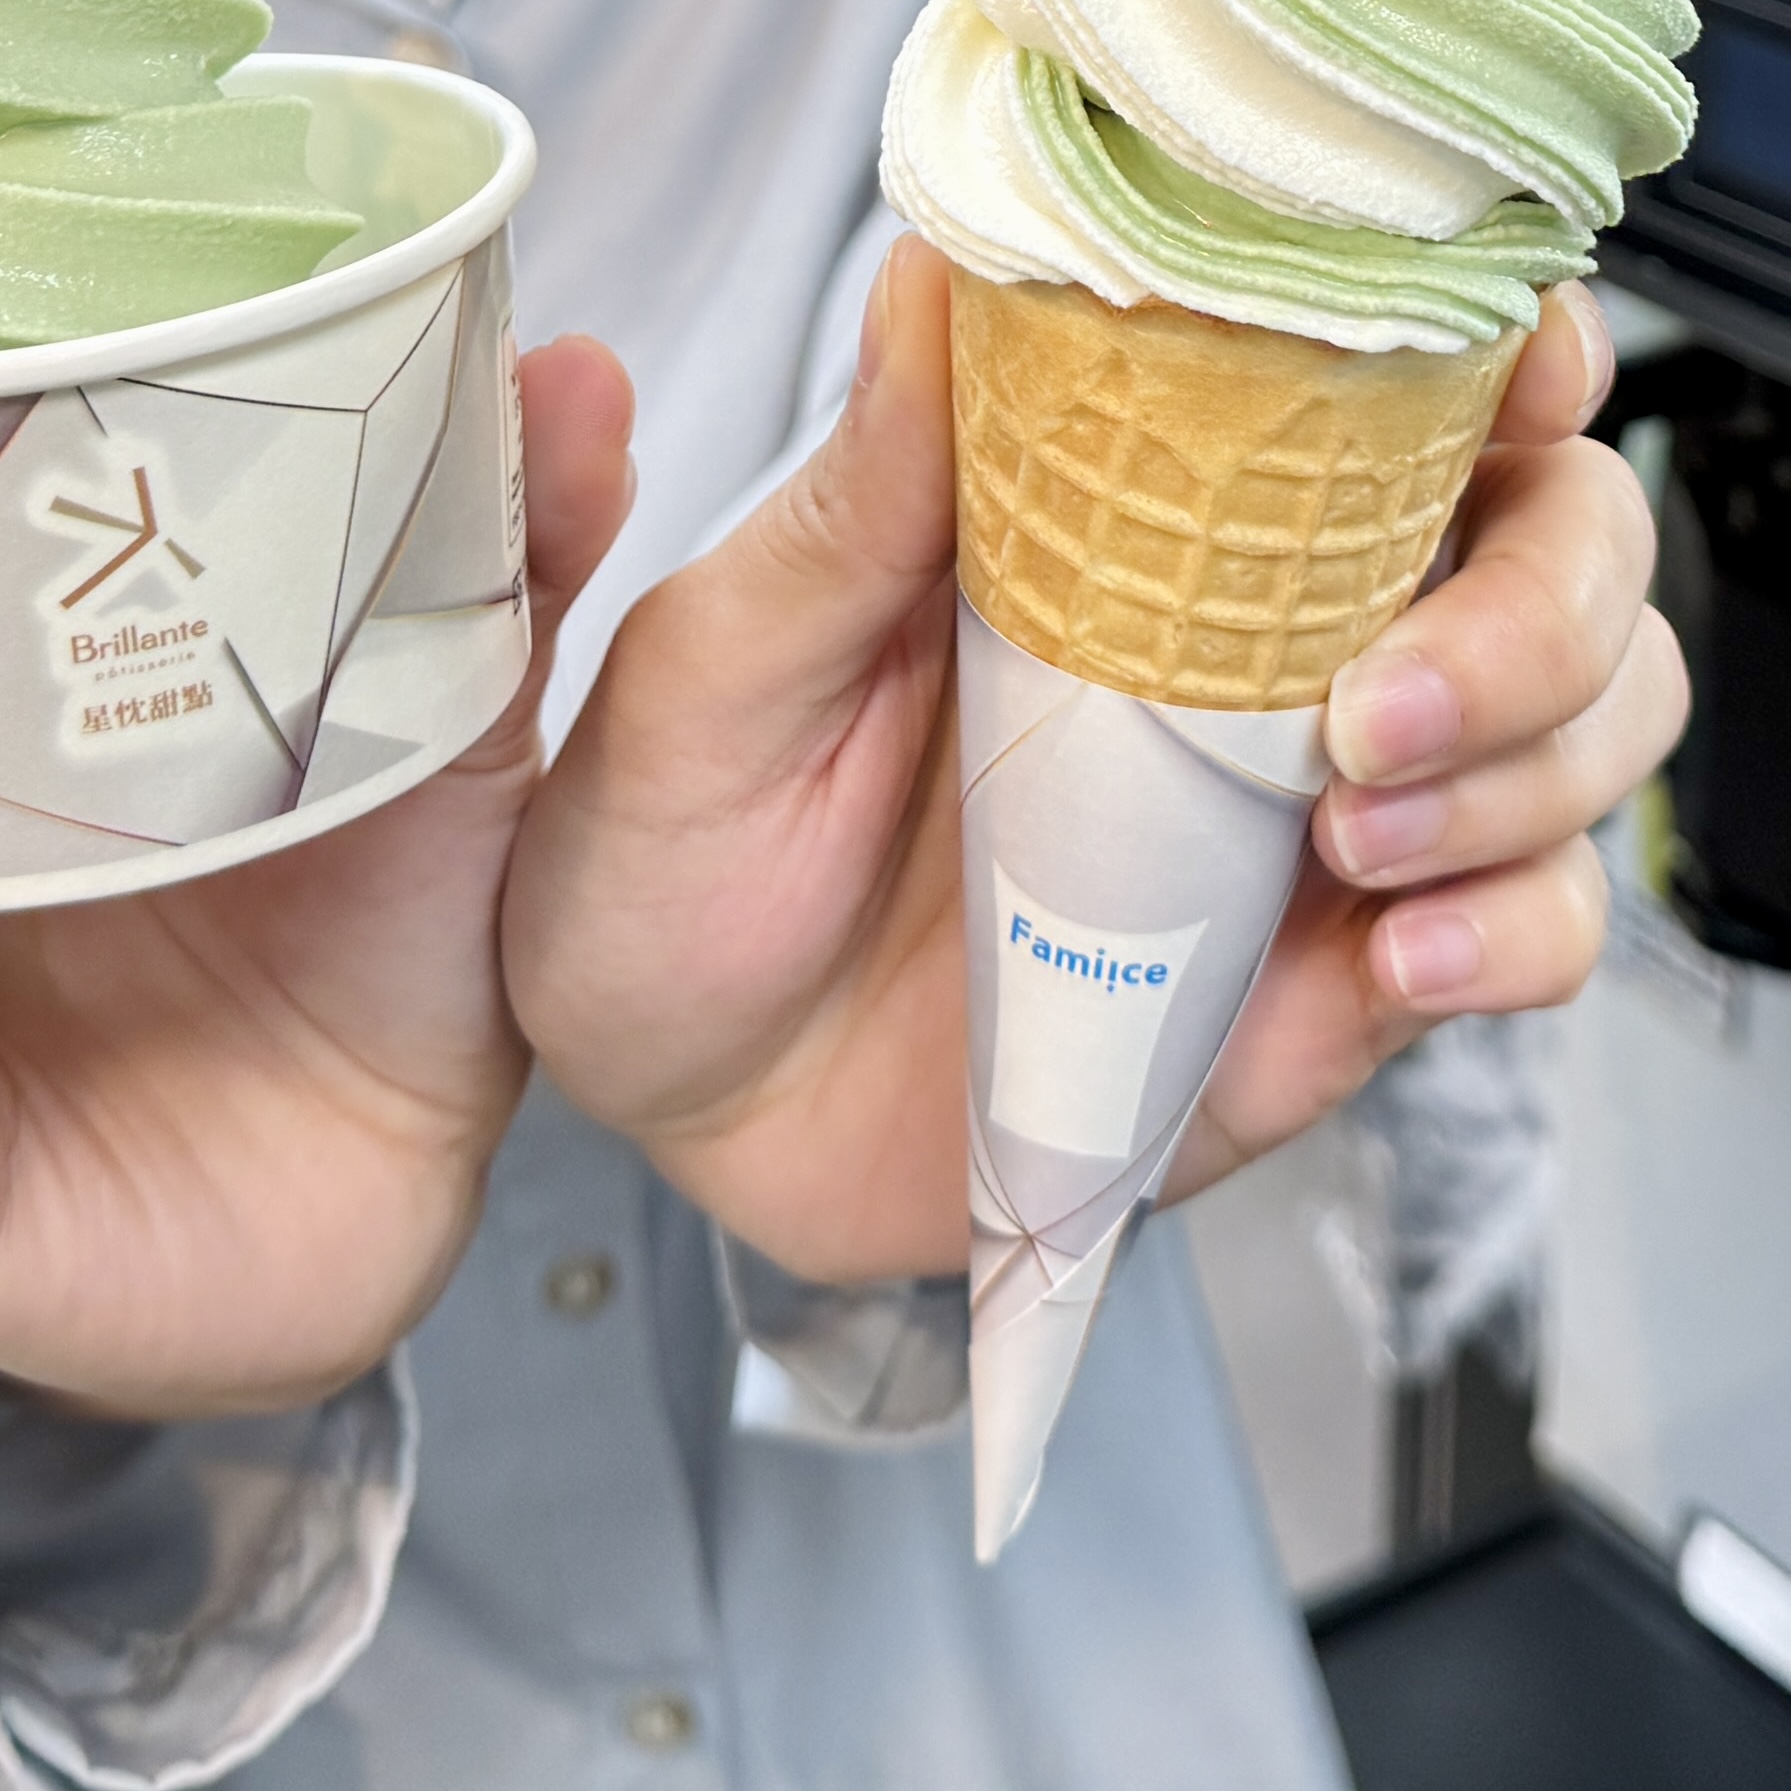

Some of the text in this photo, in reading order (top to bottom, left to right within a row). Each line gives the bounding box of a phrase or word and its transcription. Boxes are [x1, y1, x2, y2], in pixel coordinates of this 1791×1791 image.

[71, 619, 209, 664] Brillante
[80, 679, 214, 735] 星忱甜點
